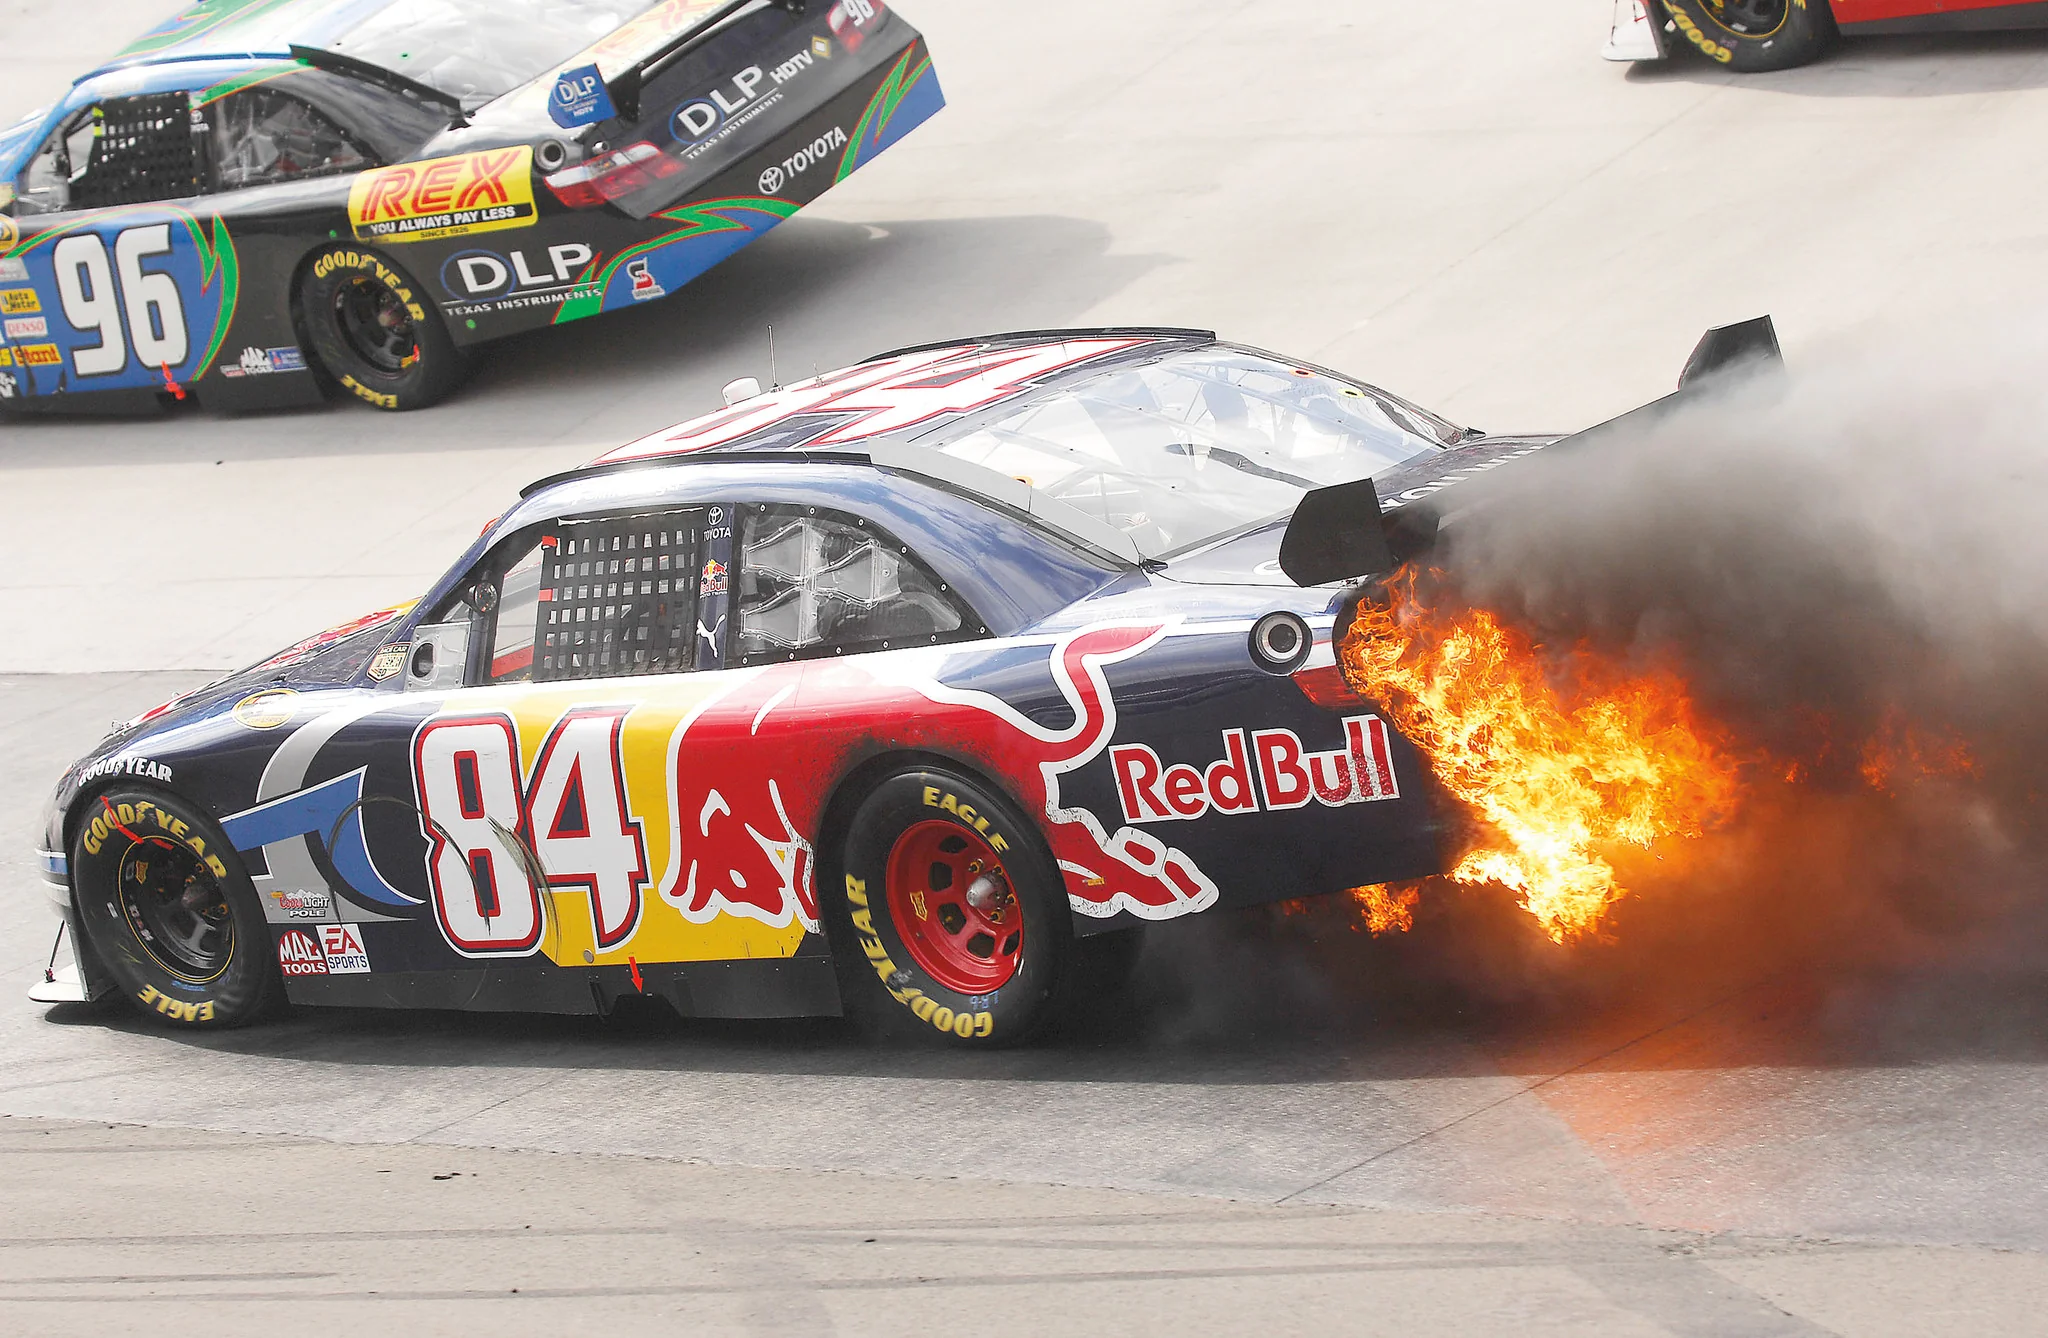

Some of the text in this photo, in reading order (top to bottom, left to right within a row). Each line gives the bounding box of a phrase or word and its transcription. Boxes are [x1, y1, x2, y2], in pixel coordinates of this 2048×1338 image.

[558, 76, 596, 100] DLP
[677, 50, 813, 136] DLP HDTV
[687, 92, 784, 159] TEXAS INSTRUMENTS
[782, 126, 848, 178] TOYOTA
[360, 149, 523, 222] REX
[370, 206, 515, 235] YOU ALWAYS PAY LESS
[420, 229, 447, 239] SINCE
[457, 243, 593, 293] DLP
[53, 223, 188, 376] 96
[314, 250, 425, 321] GOODYEAR
[446, 288, 602, 317] TEXAS INSTRUMENTS
[7, 320, 45, 335] DENSO
[704, 527, 732, 541] TOYOTA
[710, 577, 728, 593] Bull
[79, 757, 172, 787] GOODYEAR
[1109, 715, 1399, 822] Red Bull
[411, 705, 651, 956] 84
[922, 786, 1010, 854] EAGLE
[81, 800, 228, 880] GOODYEAR
[289, 909, 326, 918] POLE
[304, 897, 330, 908] LIGHT
[280, 932, 324, 962] MAC
[325, 928, 363, 955] EA
[845, 873, 994, 1038] GOODYEAR
[282, 962, 327, 975] TOOLS
[328, 955, 368, 970] SPORTS
[137, 983, 215, 1022] EAGLE
